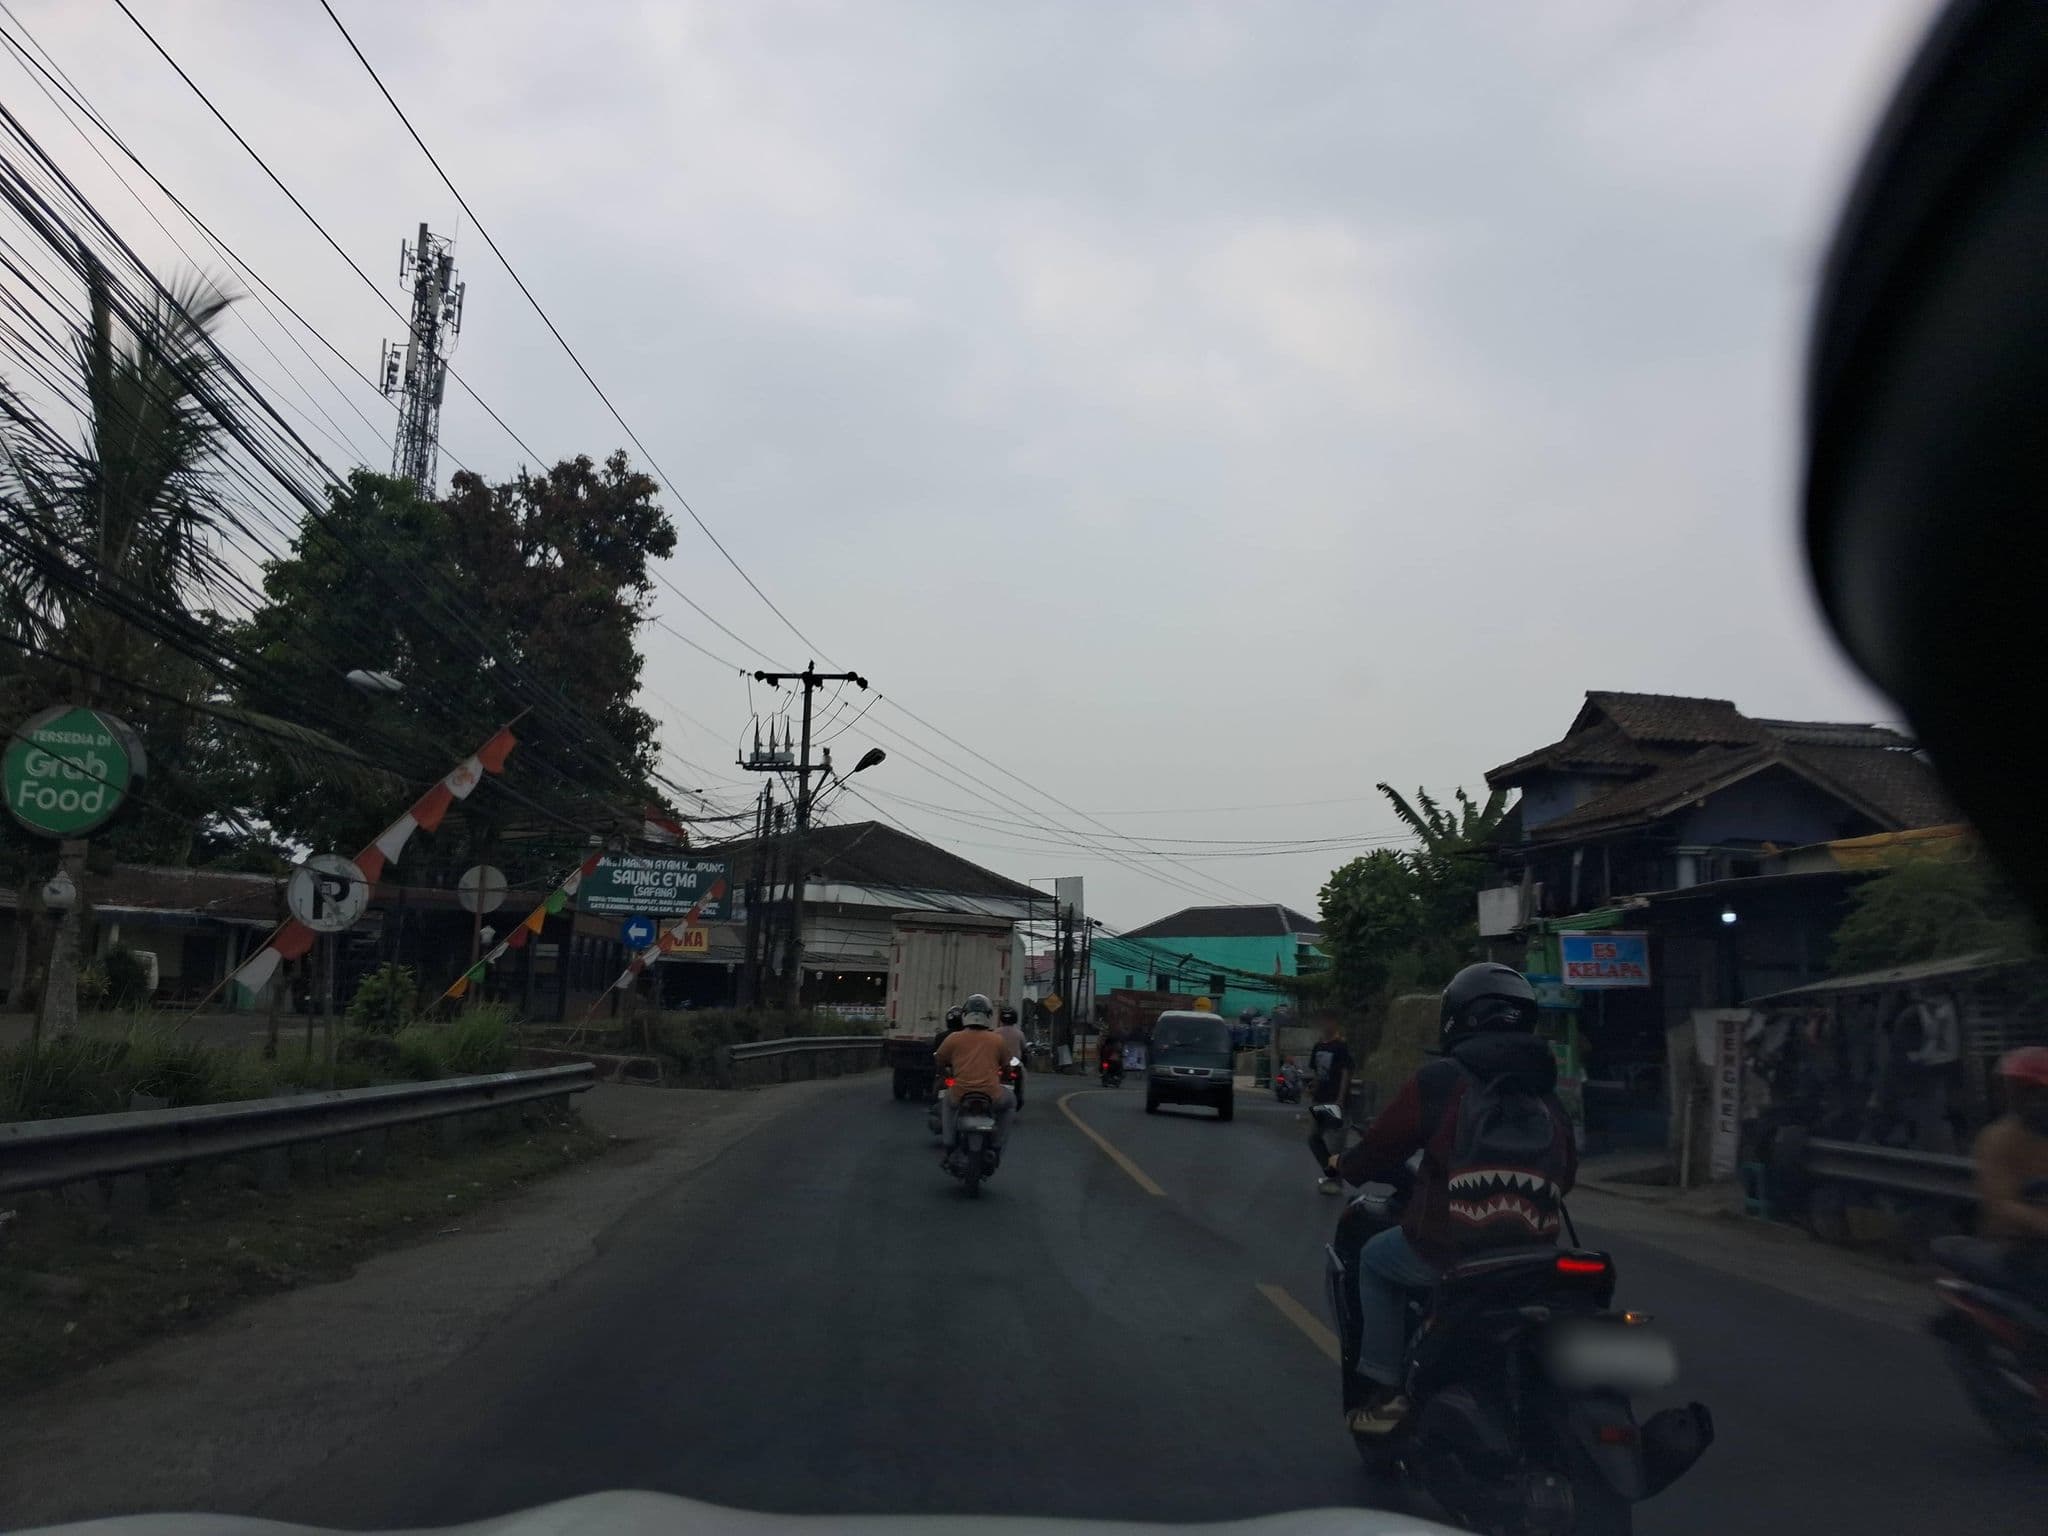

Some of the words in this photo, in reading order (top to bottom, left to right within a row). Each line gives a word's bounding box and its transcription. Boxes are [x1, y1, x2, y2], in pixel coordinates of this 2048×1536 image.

[33, 730, 94, 745] TERSEDIA
[97, 735, 112, 746] DI
[25, 749, 108, 782] Grab
[18, 780, 105, 813] Food
[612, 869, 660, 887] SAUNG
[310, 873, 350, 919] P
[663, 930, 703, 947] UKA
[1567, 962, 1643, 977] KELAPA
